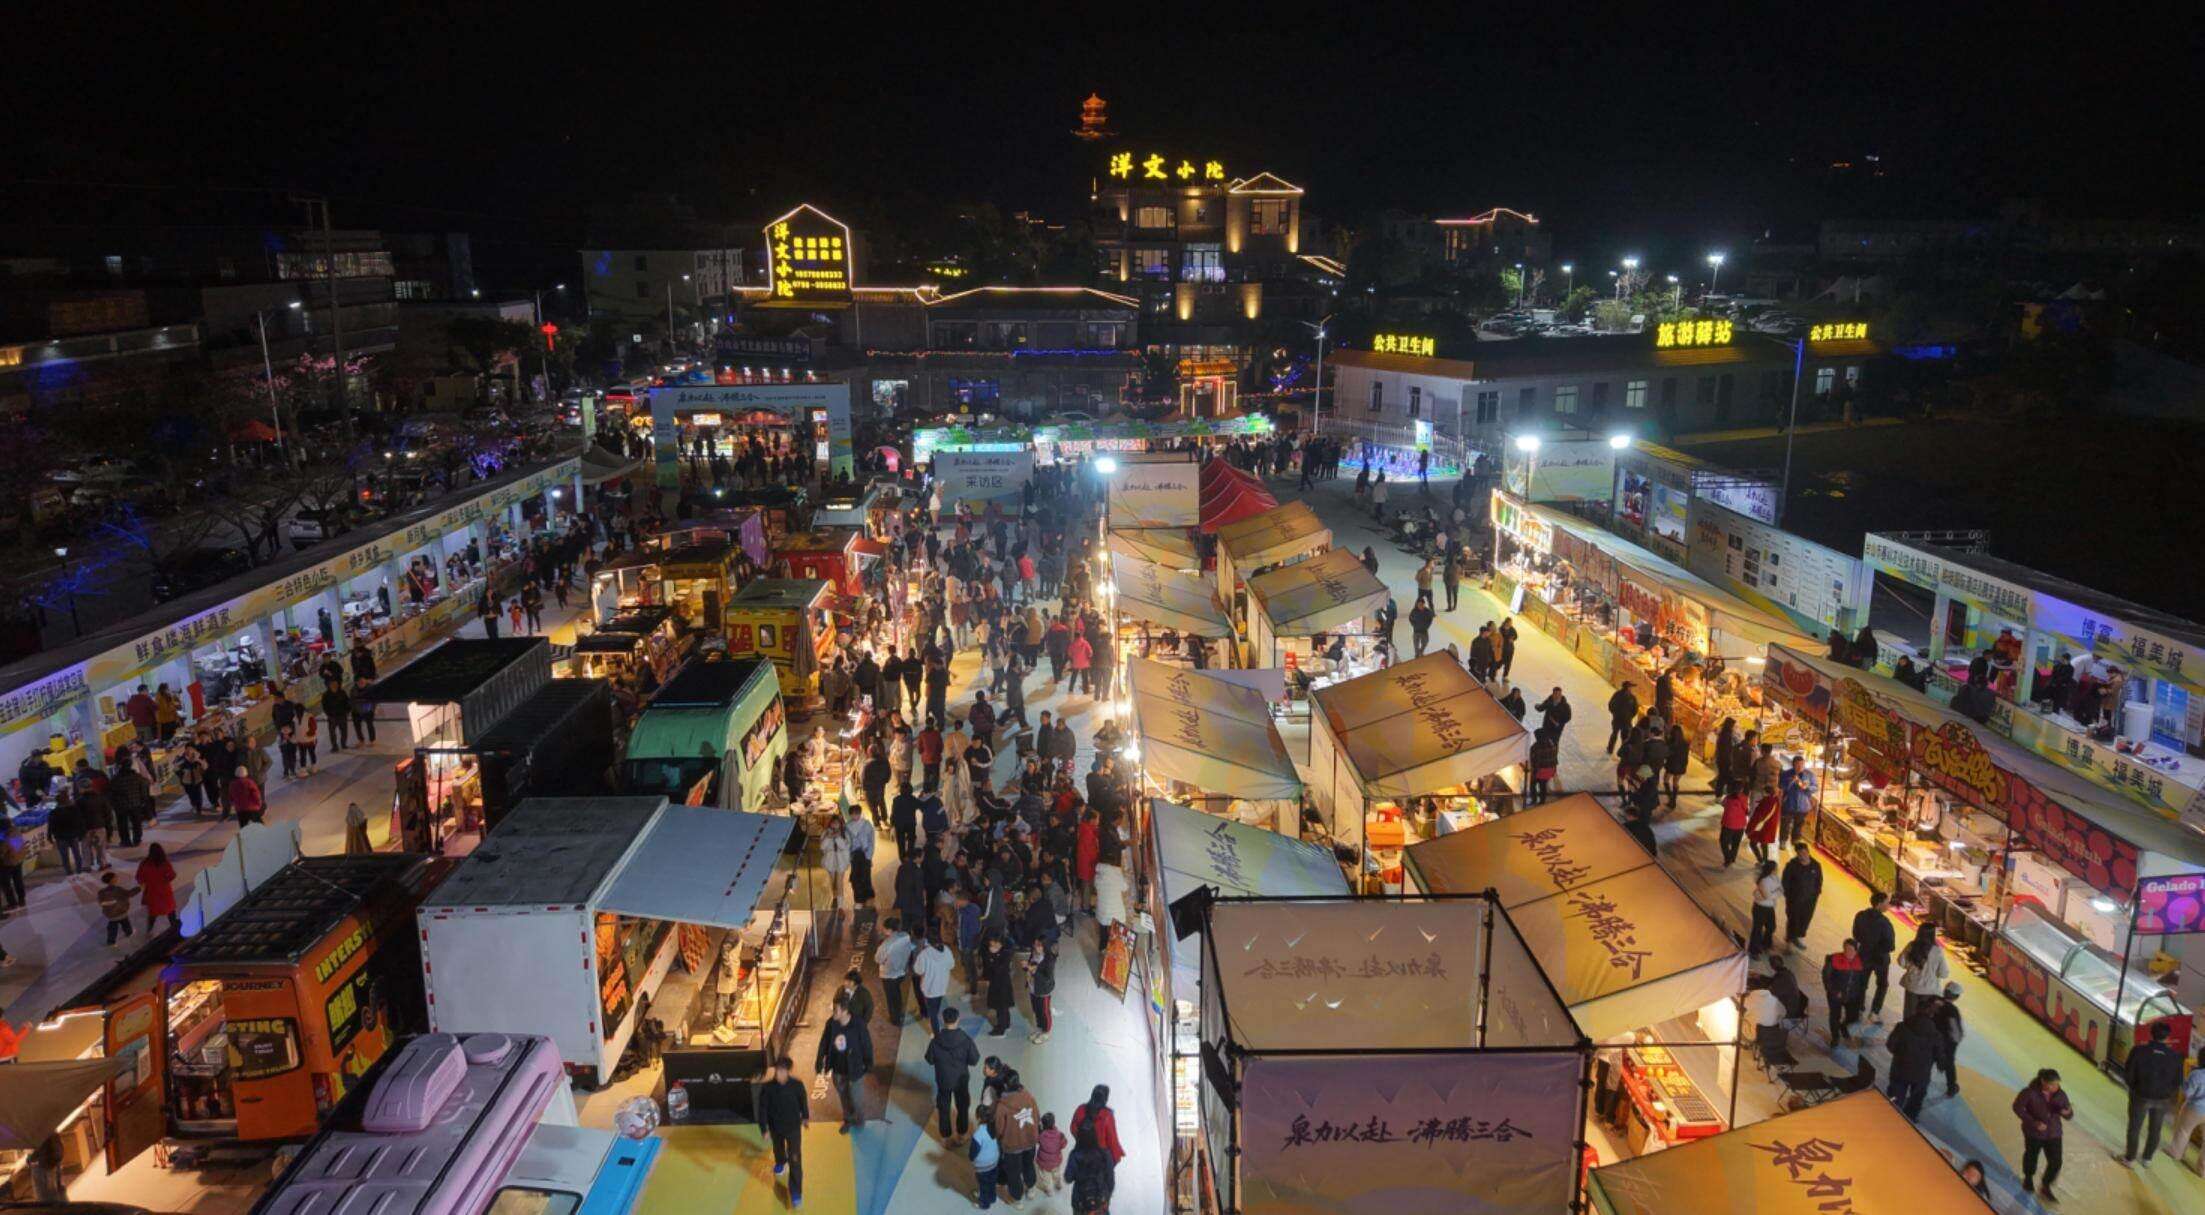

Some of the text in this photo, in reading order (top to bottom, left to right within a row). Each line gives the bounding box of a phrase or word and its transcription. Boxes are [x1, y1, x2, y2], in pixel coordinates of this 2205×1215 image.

[1656, 320, 1733, 347] 旅游驿站
[1810, 323, 1868, 342] 公共卫生间
[1374, 334, 1434, 356] 公共卫生间
[966, 475, 1003, 489] 采访区
[2146, 880, 2197, 893] Gelado
